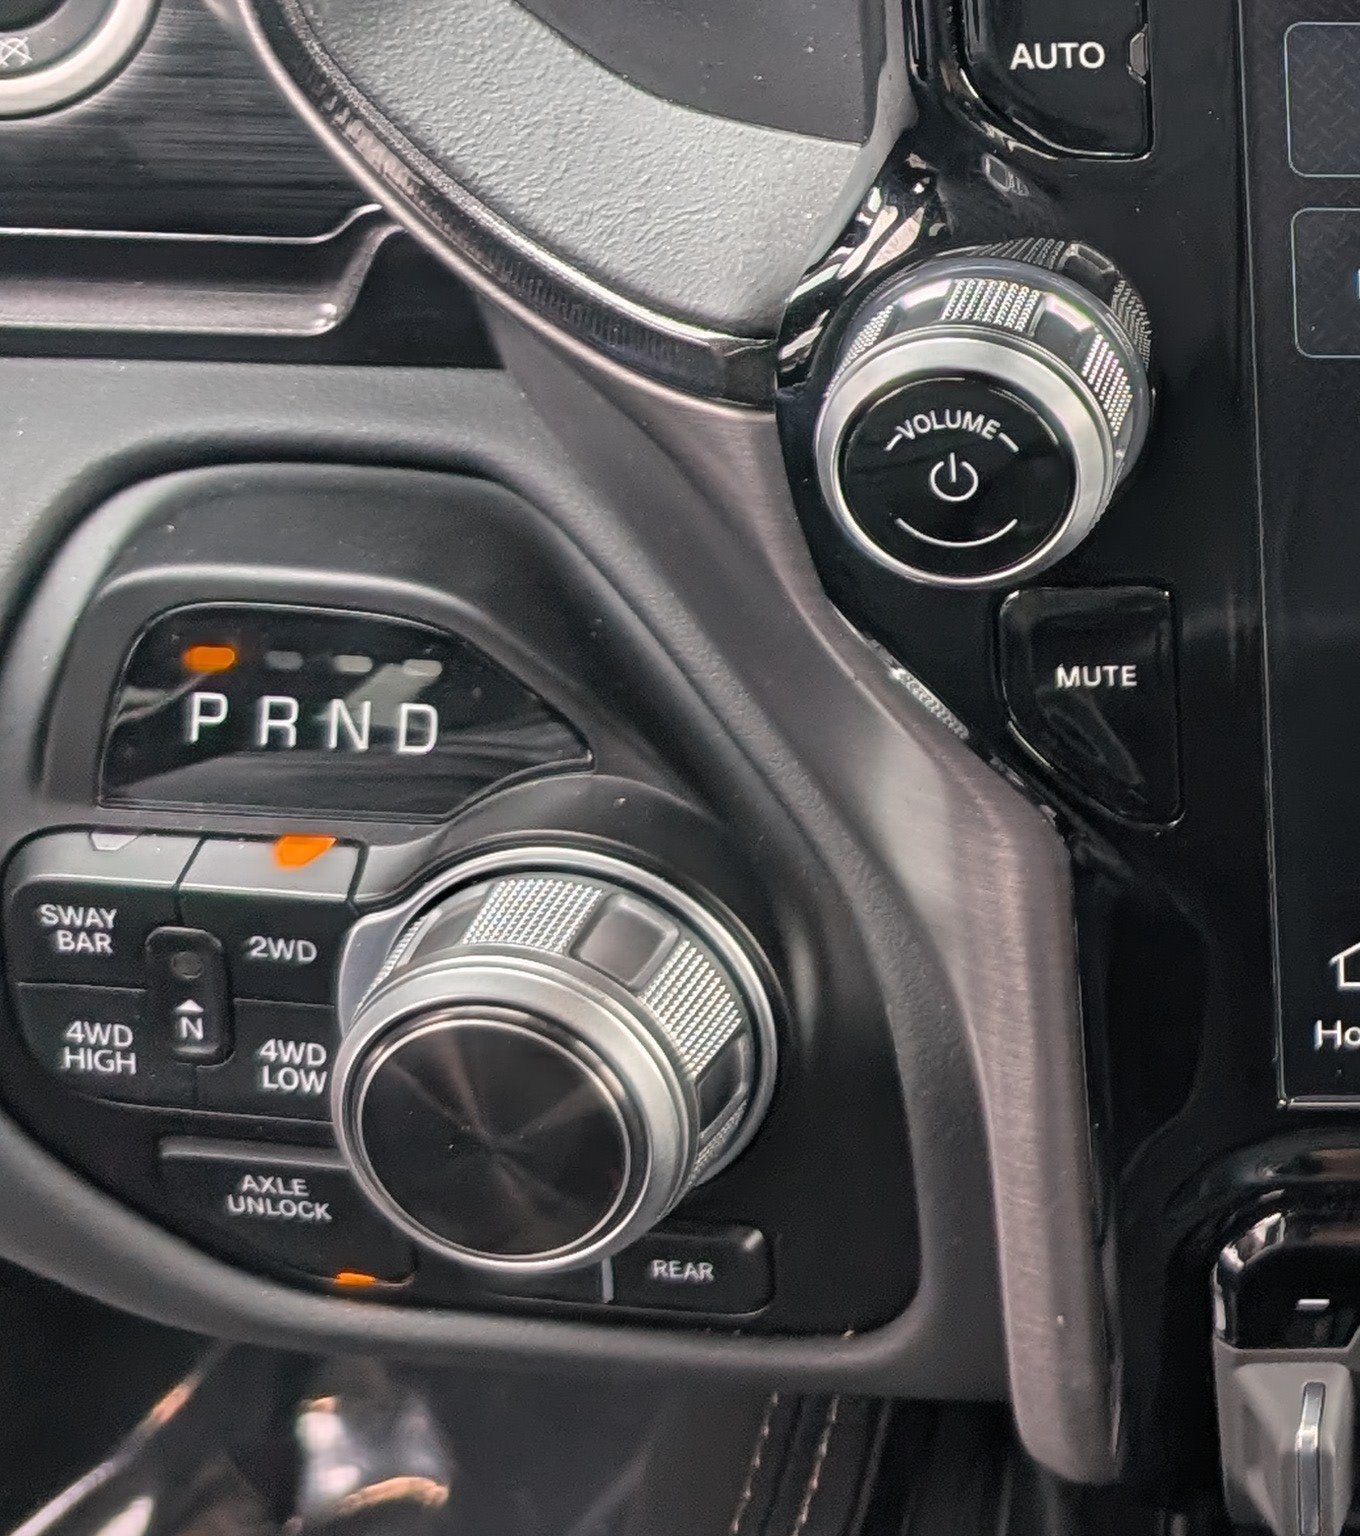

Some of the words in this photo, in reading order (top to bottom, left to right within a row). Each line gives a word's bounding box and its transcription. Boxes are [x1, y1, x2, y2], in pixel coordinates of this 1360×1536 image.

[1010, 41, 1105, 70] AUTO
[897, 409, 1000, 440] VOLUME
[1056, 665, 1137, 688] MUTE
[189, 691, 229, 743] P
[259, 695, 299, 748] R
[326, 698, 372, 751] N
[396, 702, 438, 755] D
[39, 903, 117, 931] SWAY
[56, 929, 113, 954] BAR
[248, 935, 318, 962] 2WD
[64, 1020, 134, 1047] 4WD
[180, 1016, 204, 1040] N
[63, 1047, 137, 1075] HIGH
[259, 1038, 327, 1066] 4WD
[262, 1065, 327, 1094] LOW
[239, 1174, 309, 1197] AXLE
[227, 1195, 332, 1221] UNLOCK
[652, 1259, 714, 1281] REAR
